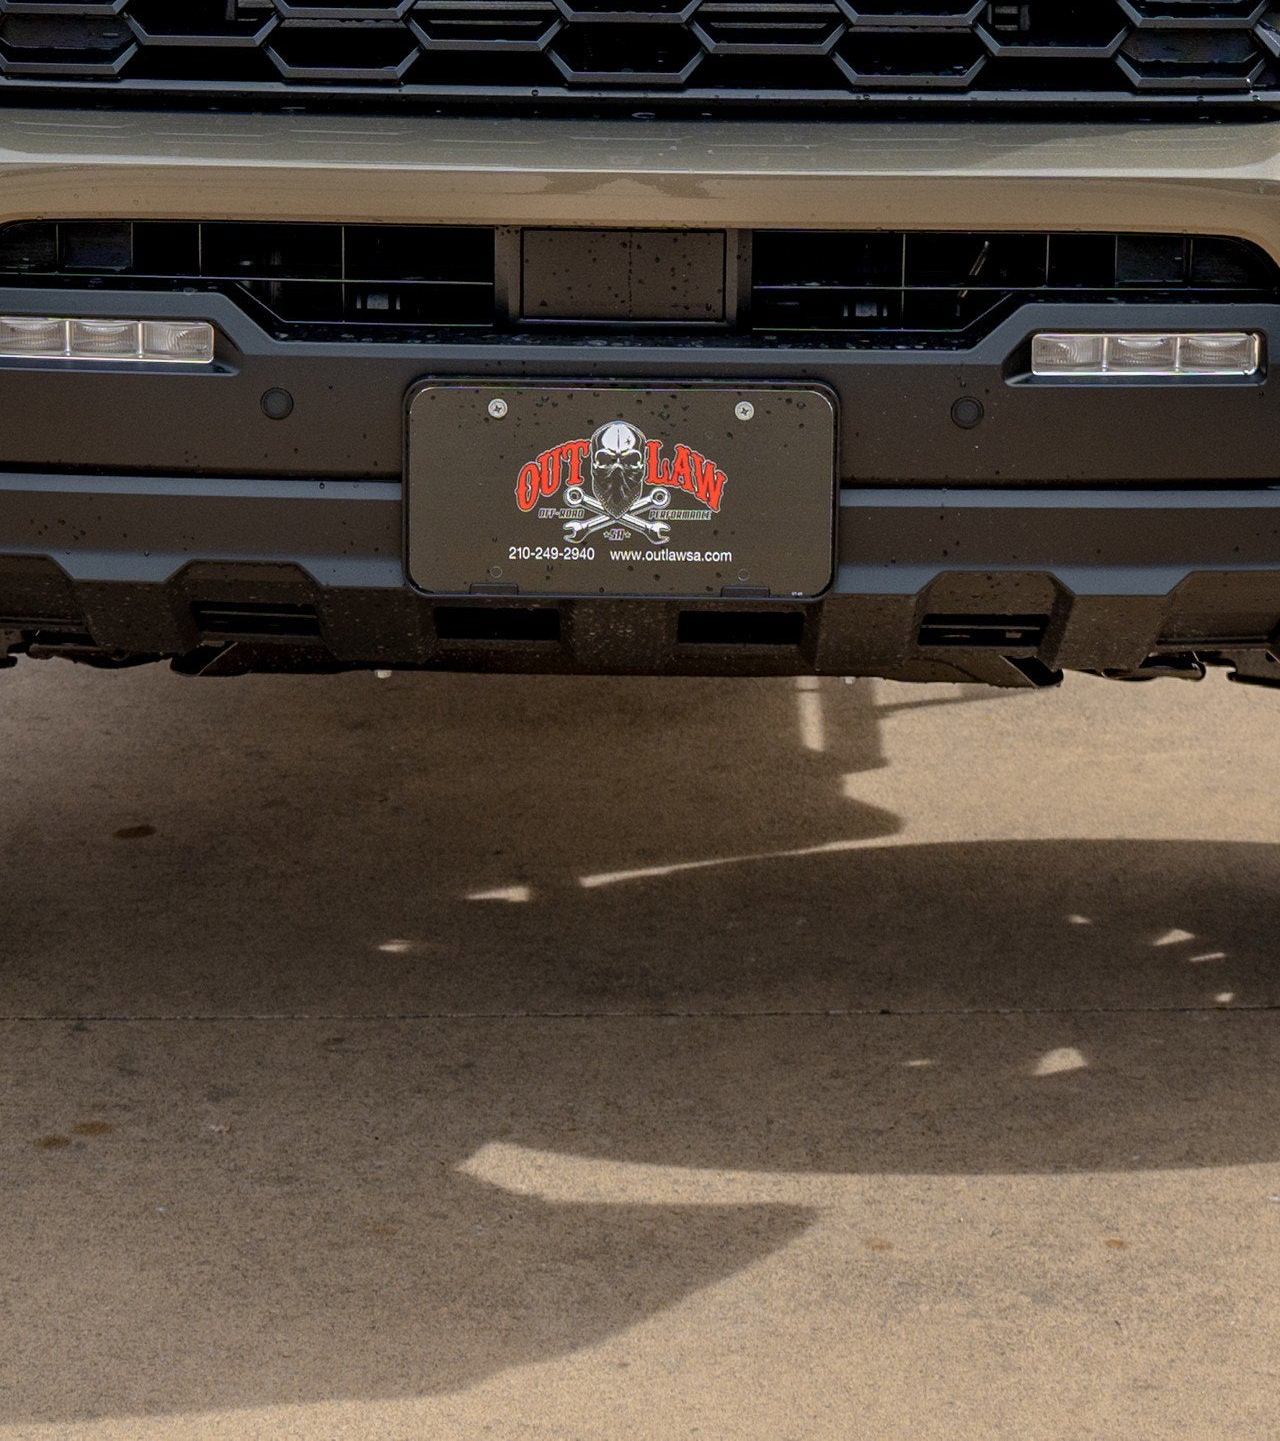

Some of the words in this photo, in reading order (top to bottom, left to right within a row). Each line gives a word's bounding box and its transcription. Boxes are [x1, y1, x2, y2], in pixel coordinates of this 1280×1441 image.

[514, 439, 592, 512] OUT
[645, 439, 729, 513] LAW
[538, 507, 585, 519] OFF-ROAD
[648, 509, 713, 521] PERFORMANCE
[508, 546, 595, 561] 210-249-2940
[609, 548, 733, 563] www.outlawsa.com
